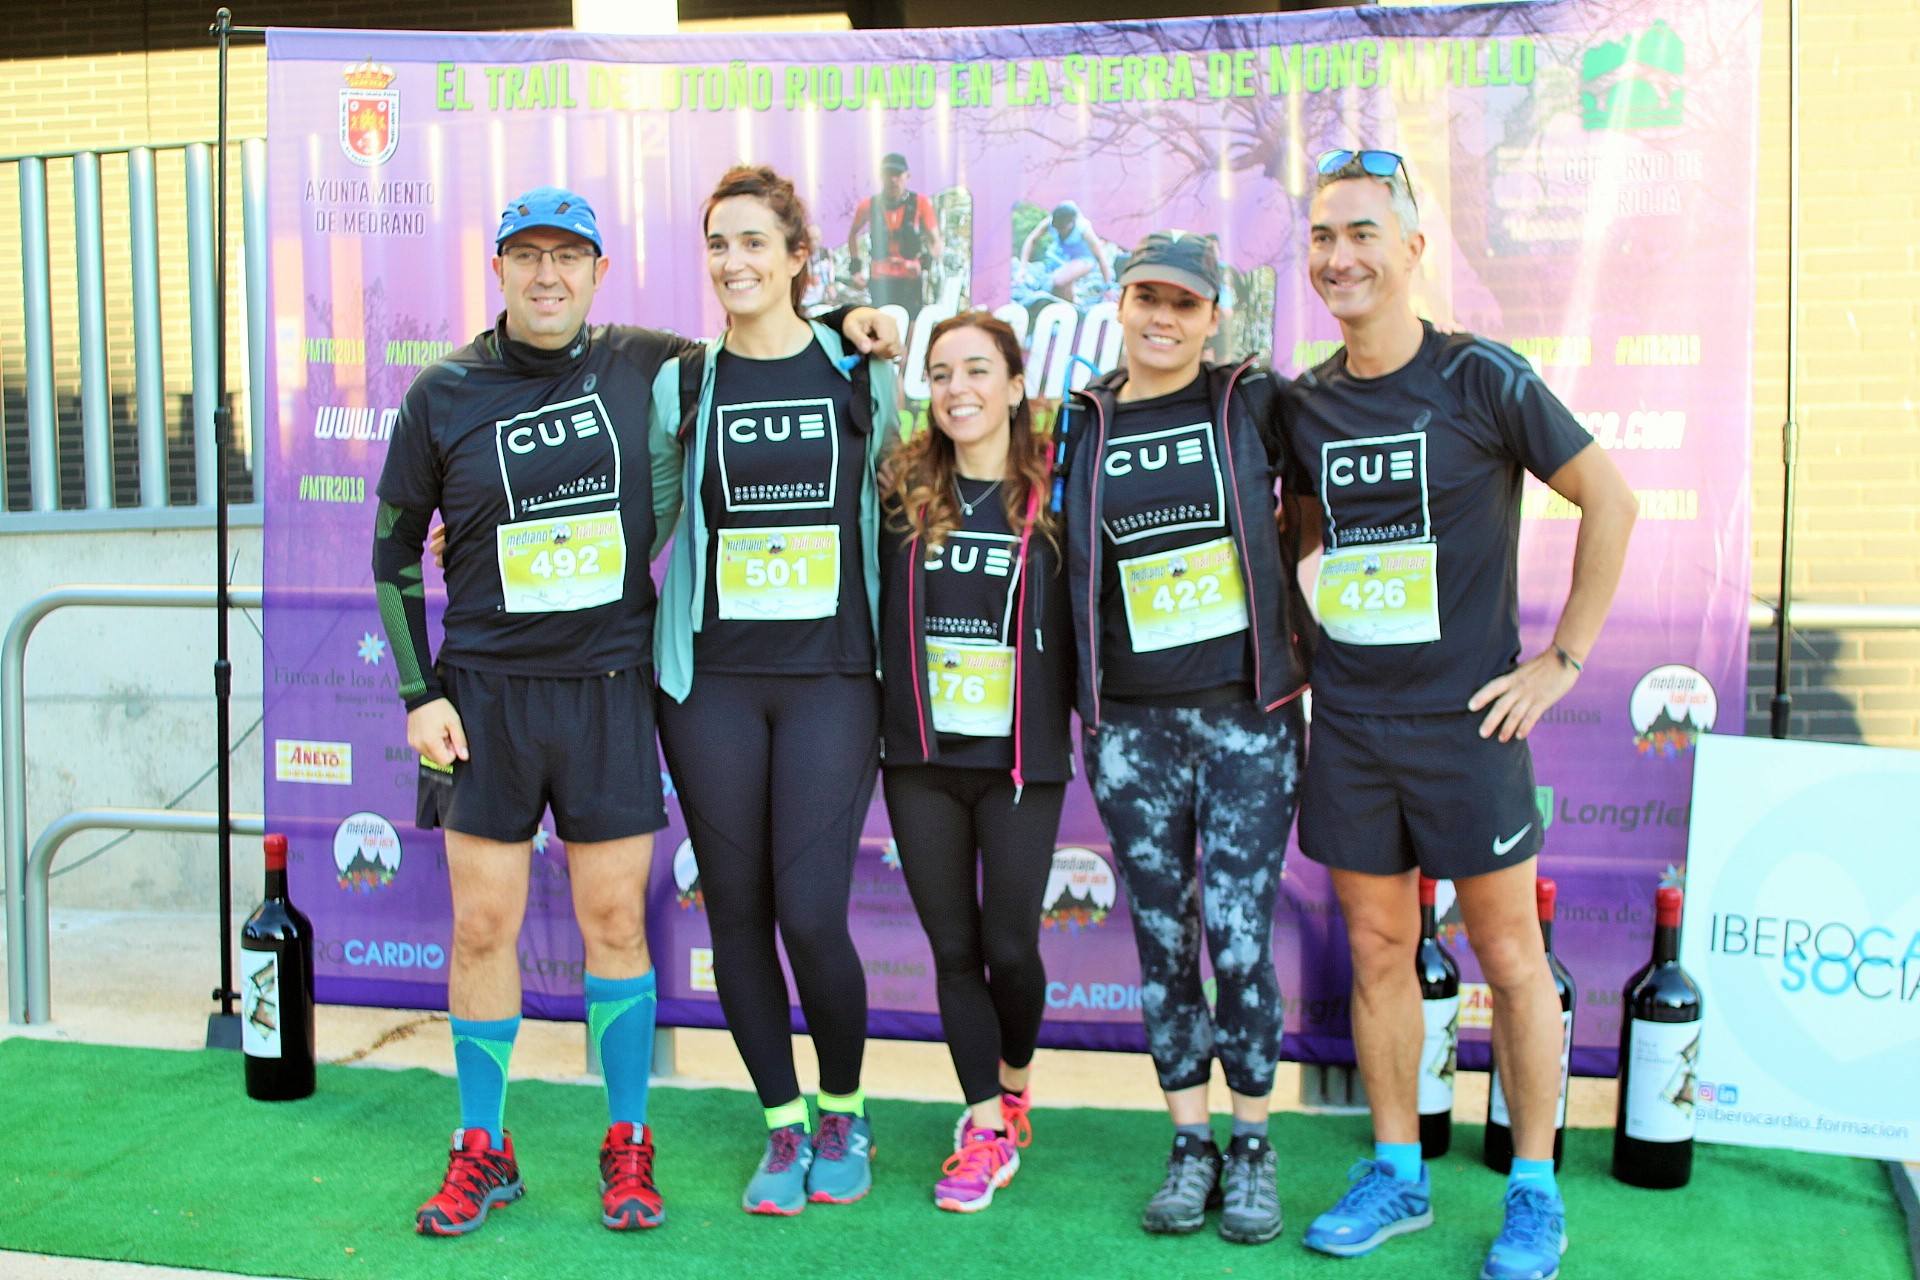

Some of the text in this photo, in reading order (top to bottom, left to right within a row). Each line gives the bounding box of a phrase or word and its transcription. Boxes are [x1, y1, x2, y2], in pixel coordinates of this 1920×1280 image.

[436, 60, 474, 111] EL
[485, 63, 578, 112] TRAIL
[784, 63, 937, 112] RIOJANO
[949, 61, 993, 108] EN
[1005, 60, 1051, 107] LA
[1062, 53, 1198, 105] SIERRA
[1208, 49, 1257, 100] DE
[304, 179, 436, 206] AYUNTAMIENTO
[315, 209, 426, 236] DE MEDRANO
[507, 410, 600, 454] CUE
[728, 413, 825, 444] CUE
[1104, 436, 1204, 477] CUE
[1329, 450, 1414, 487] CUE
[299, 474, 366, 504] #MTR2018
[529, 544, 601, 579] 492
[744, 557, 809, 587] 501
[924, 544, 1012, 577] CUE
[1151, 574, 1223, 614] 422
[1339, 578, 1407, 611] 426
[273, 667, 320, 687] Finca
[324, 668, 345, 687] de
[351, 669, 375, 688] los
[290, 745, 340, 768] ANETO
